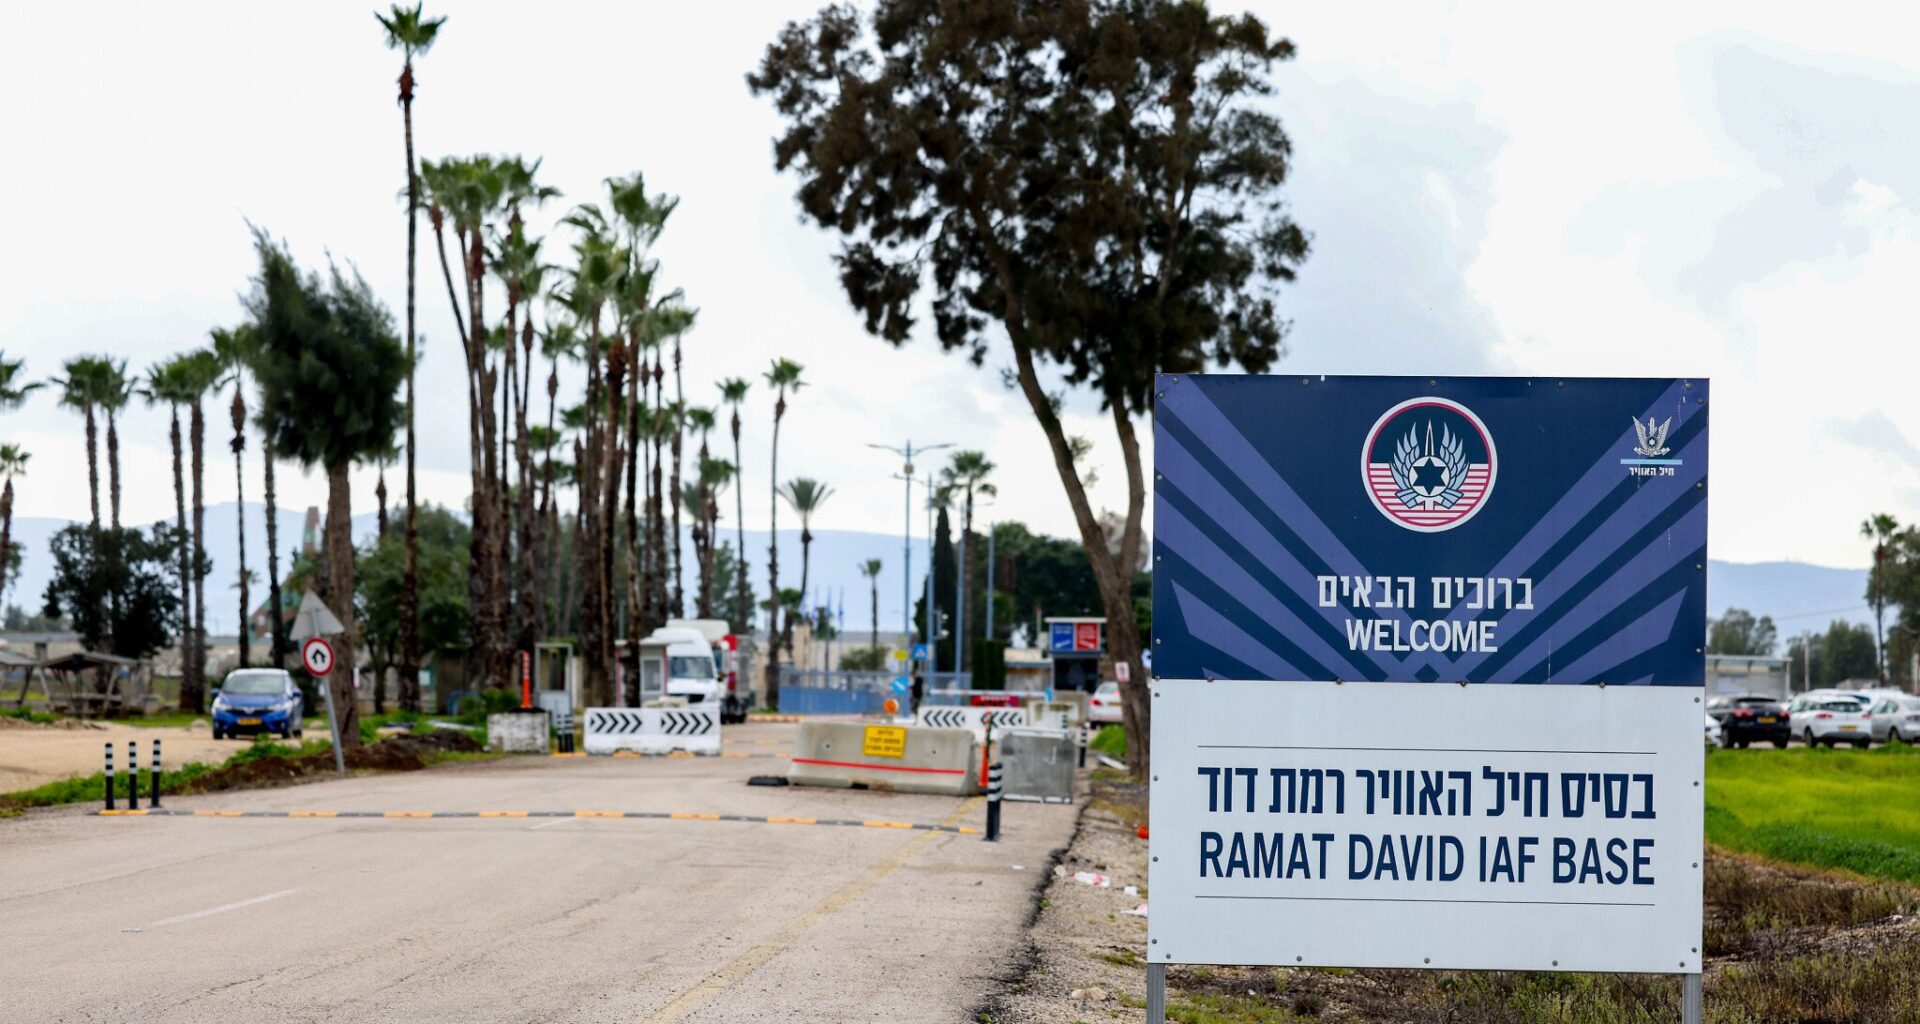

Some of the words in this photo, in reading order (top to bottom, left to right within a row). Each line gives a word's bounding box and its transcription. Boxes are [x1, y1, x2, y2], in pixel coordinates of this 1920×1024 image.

[1628, 467, 1657, 477] האוויר
[1659, 467, 1675, 477] חיל
[1317, 575, 1416, 609] הבאים
[1431, 577, 1534, 610] ברוכים
[1345, 618, 1498, 653] WELCOME
[1197, 766, 1259, 813] דוד
[1268, 768, 1345, 815] רמת
[1355, 769, 1472, 817] האוויר
[1482, 765, 1549, 818] חיל
[1560, 772, 1657, 819] בסיס
[1199, 831, 1335, 880] RAMAT
[1348, 833, 1465, 882] DAVID
[1479, 835, 1540, 883] IAF
[1552, 837, 1655, 886] BASE
